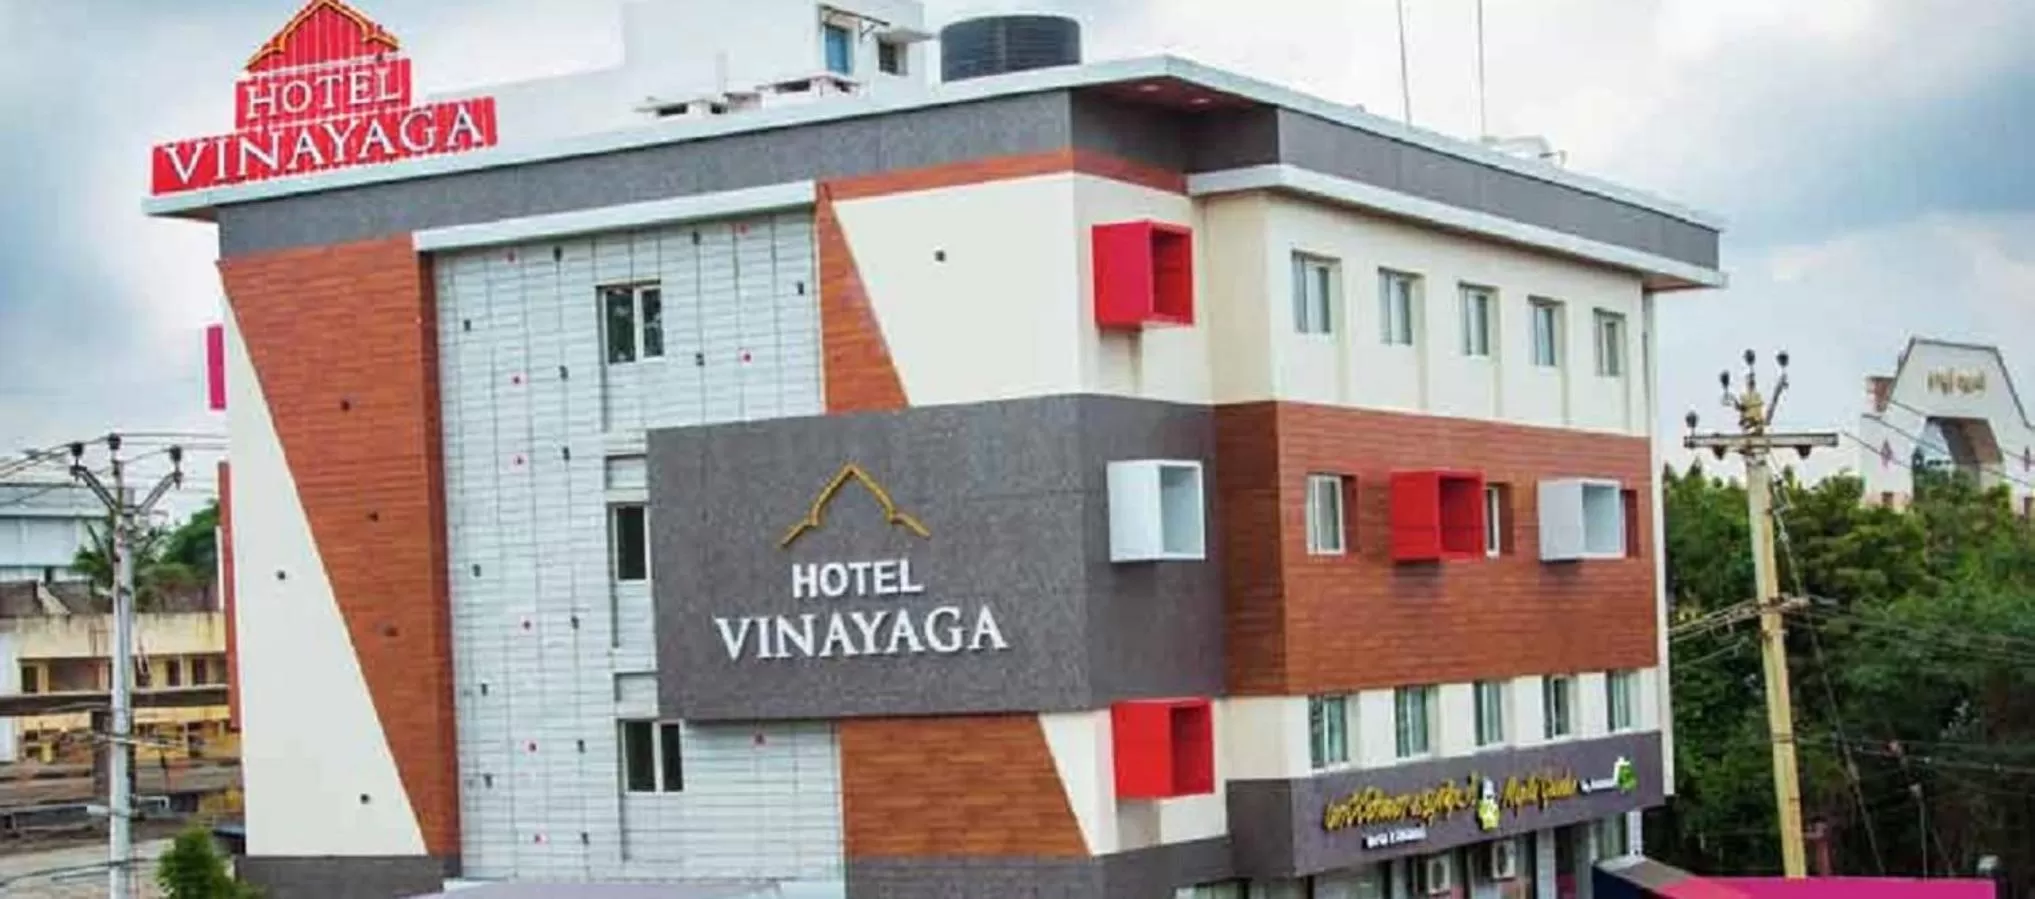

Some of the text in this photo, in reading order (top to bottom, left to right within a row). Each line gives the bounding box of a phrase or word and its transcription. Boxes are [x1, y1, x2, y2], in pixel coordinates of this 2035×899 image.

[245, 67, 402, 119] HOTEL
[166, 104, 485, 185] VINAYAGA
[791, 557, 925, 599] HOTEL
[713, 603, 1009, 662] VINAYAGA
